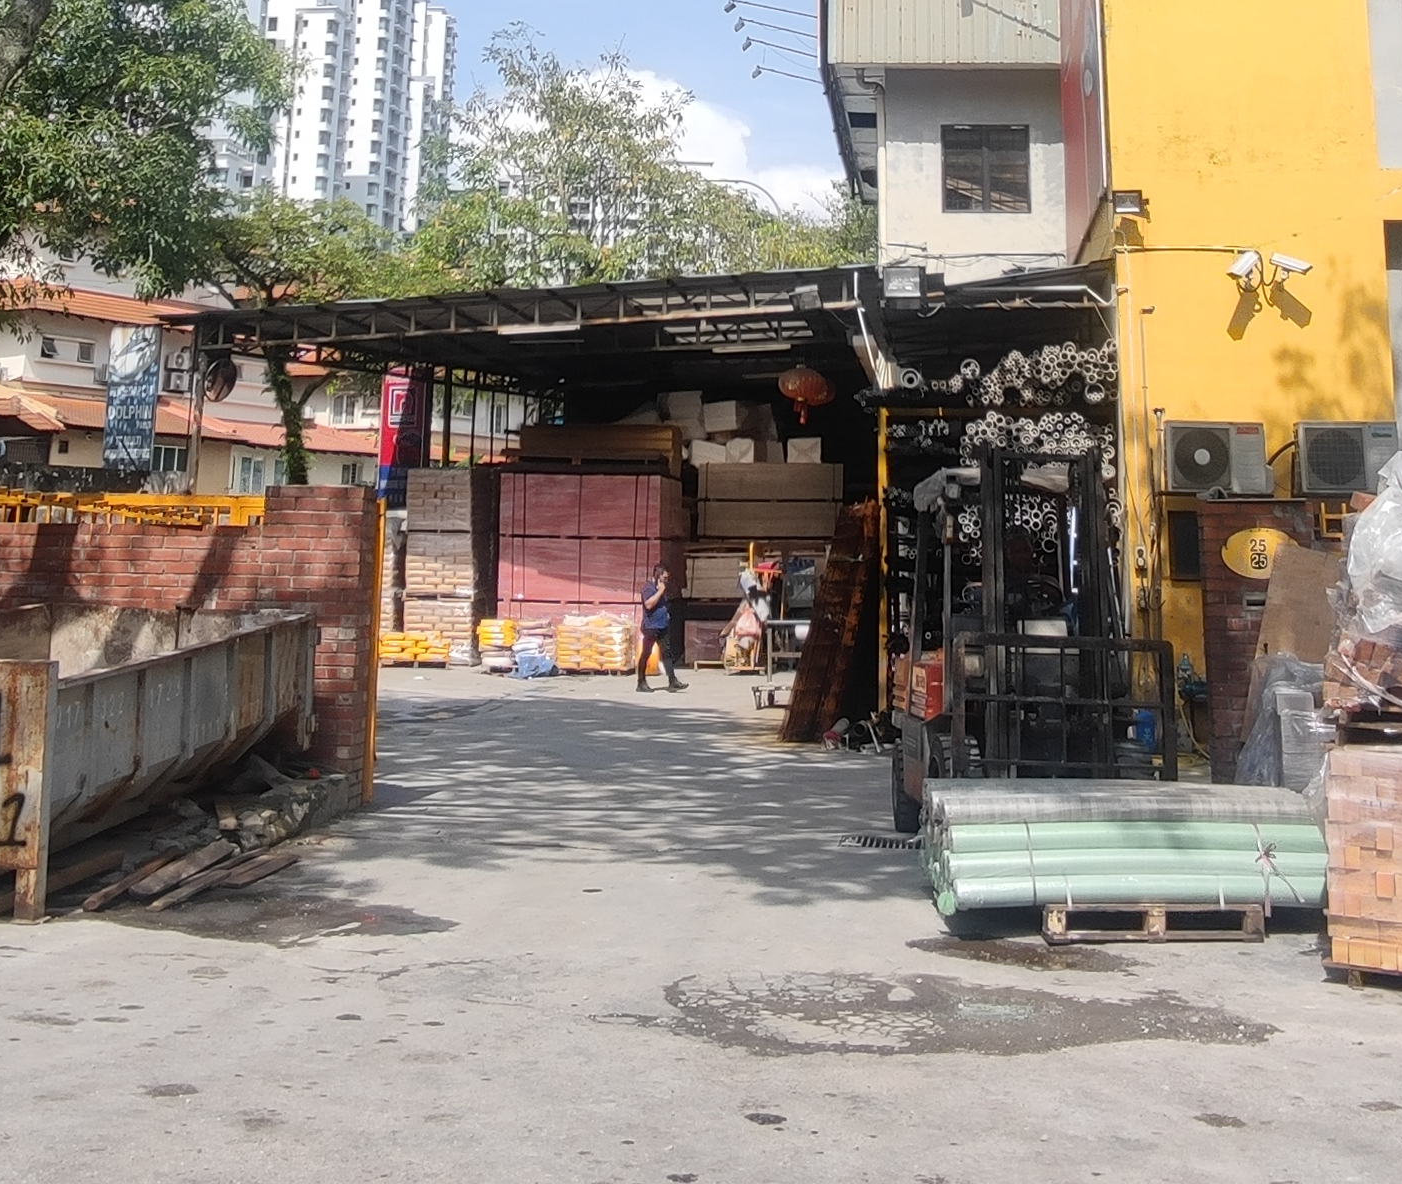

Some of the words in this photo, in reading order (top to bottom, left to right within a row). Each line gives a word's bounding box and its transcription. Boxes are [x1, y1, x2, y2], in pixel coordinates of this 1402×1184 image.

[107, 404, 154, 420] DOLPHIN
[1250, 539, 1267, 552] 25
[1251, 555, 1267, 567] 25
